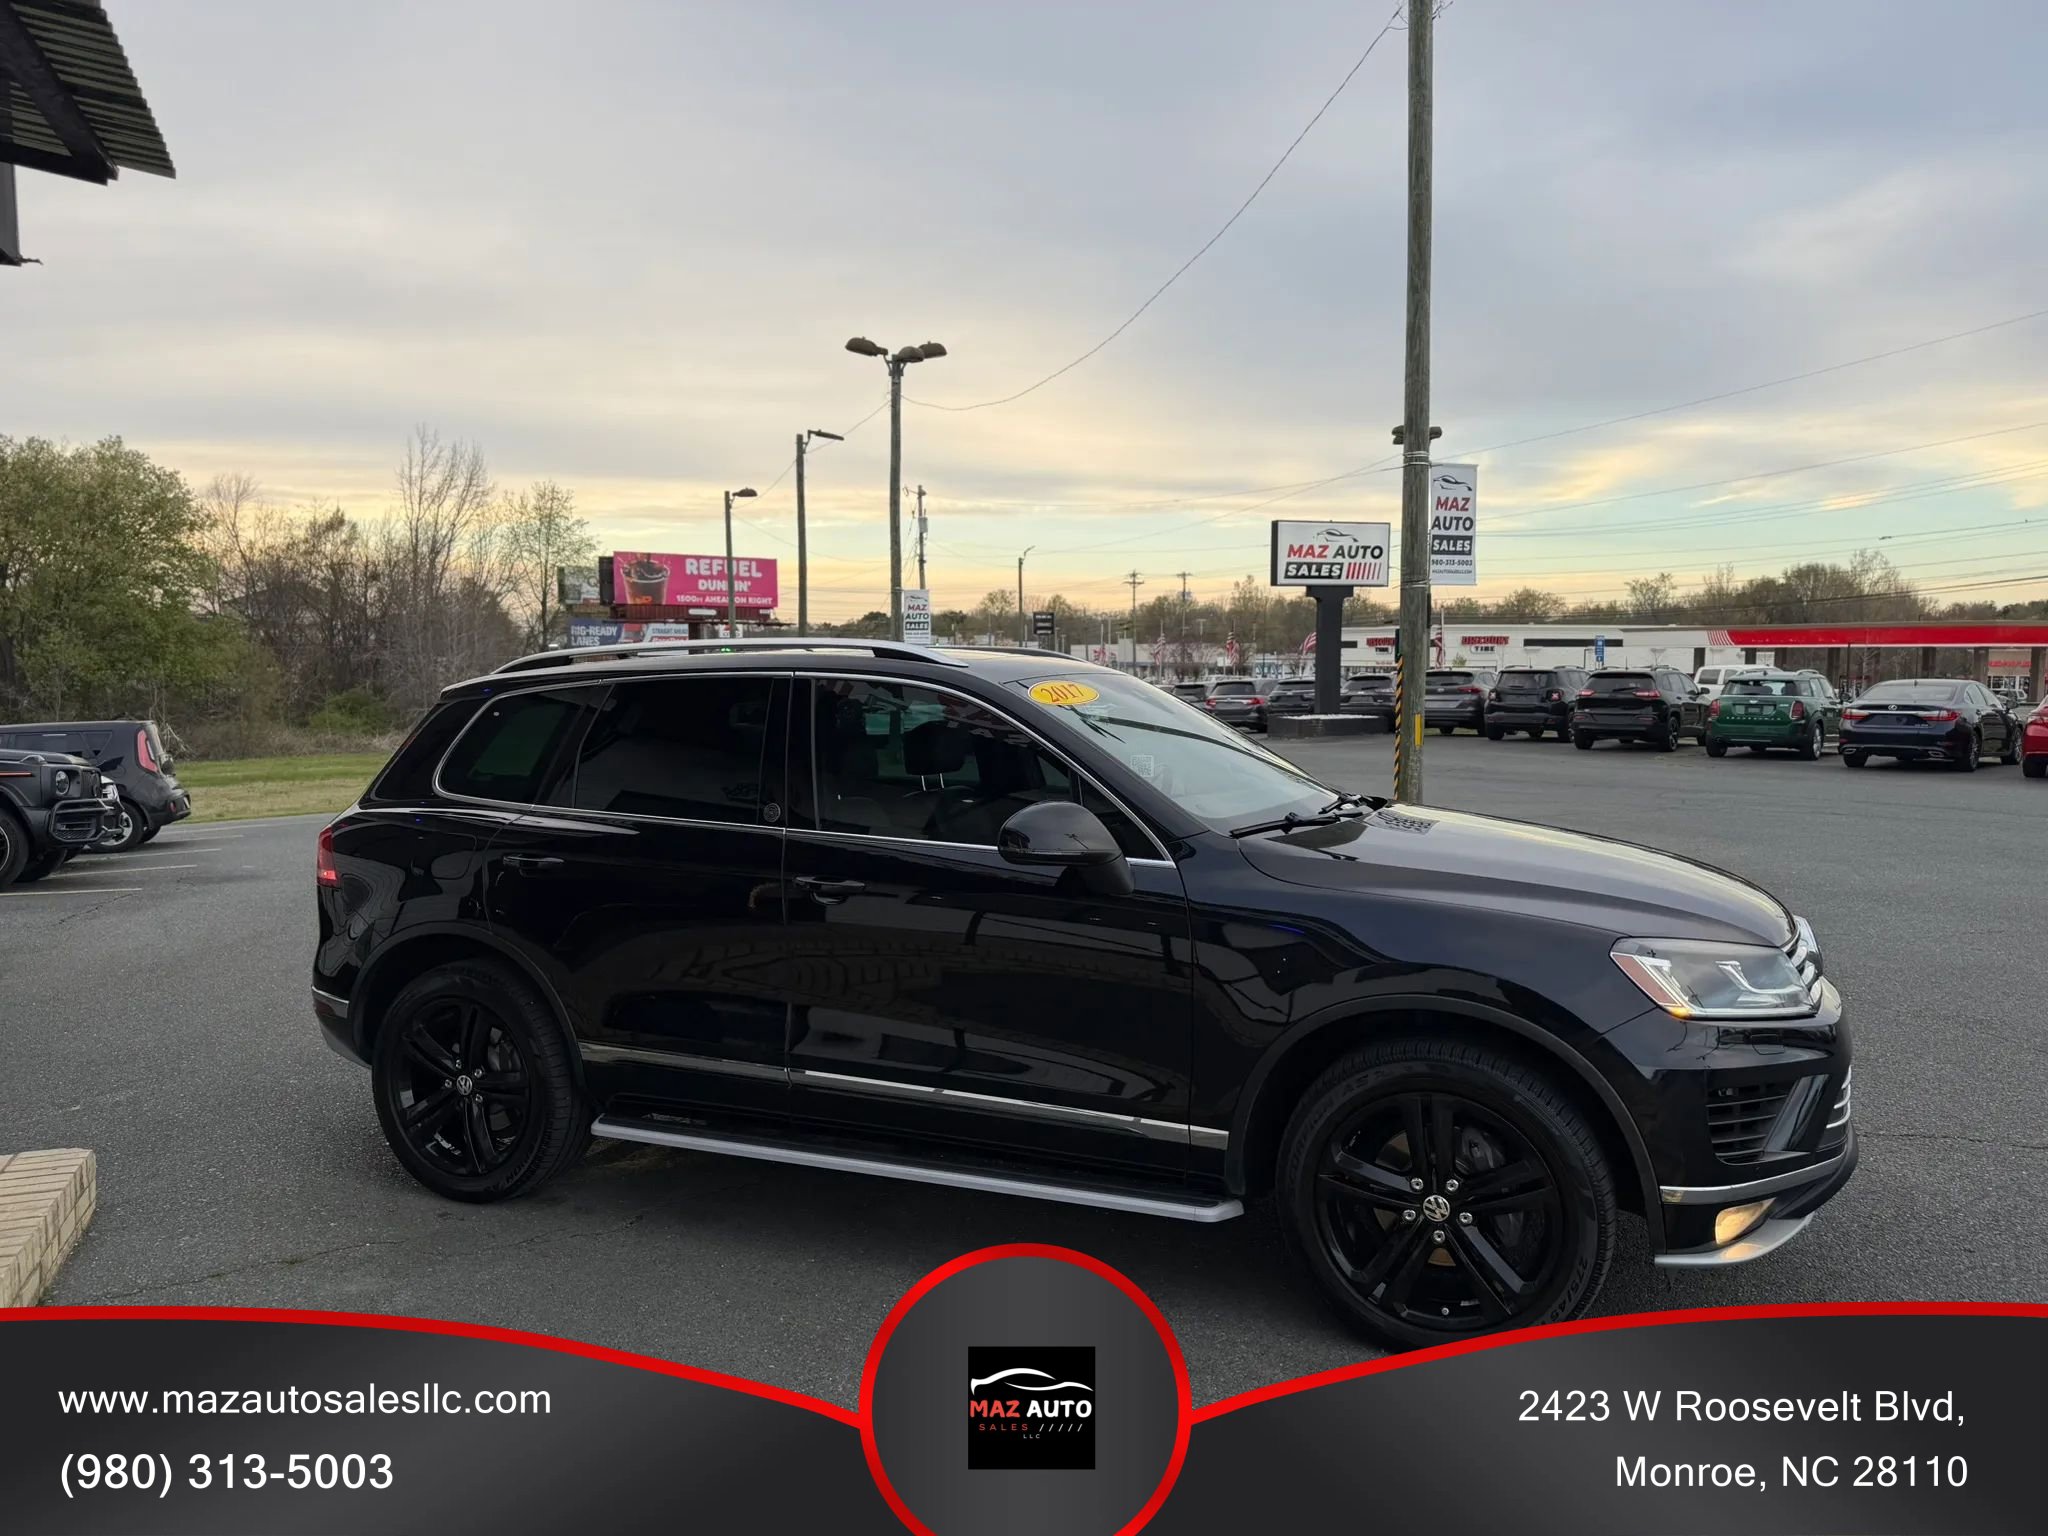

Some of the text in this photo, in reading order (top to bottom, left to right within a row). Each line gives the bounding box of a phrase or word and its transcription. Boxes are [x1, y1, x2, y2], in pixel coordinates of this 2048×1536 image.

[1435, 496, 1470, 511] MAZ
[1431, 516, 1473, 531] AUTO
[1287, 544, 1384, 560] MAZ AUTO
[1432, 539, 1471, 552] SALES
[1287, 564, 1341, 577] SALES
[698, 579, 751, 592] DUNIN'
[705, 595, 732, 603] AHEA
[748, 597, 773, 605] RIGHT
[1040, 683, 1085, 703] 2017
